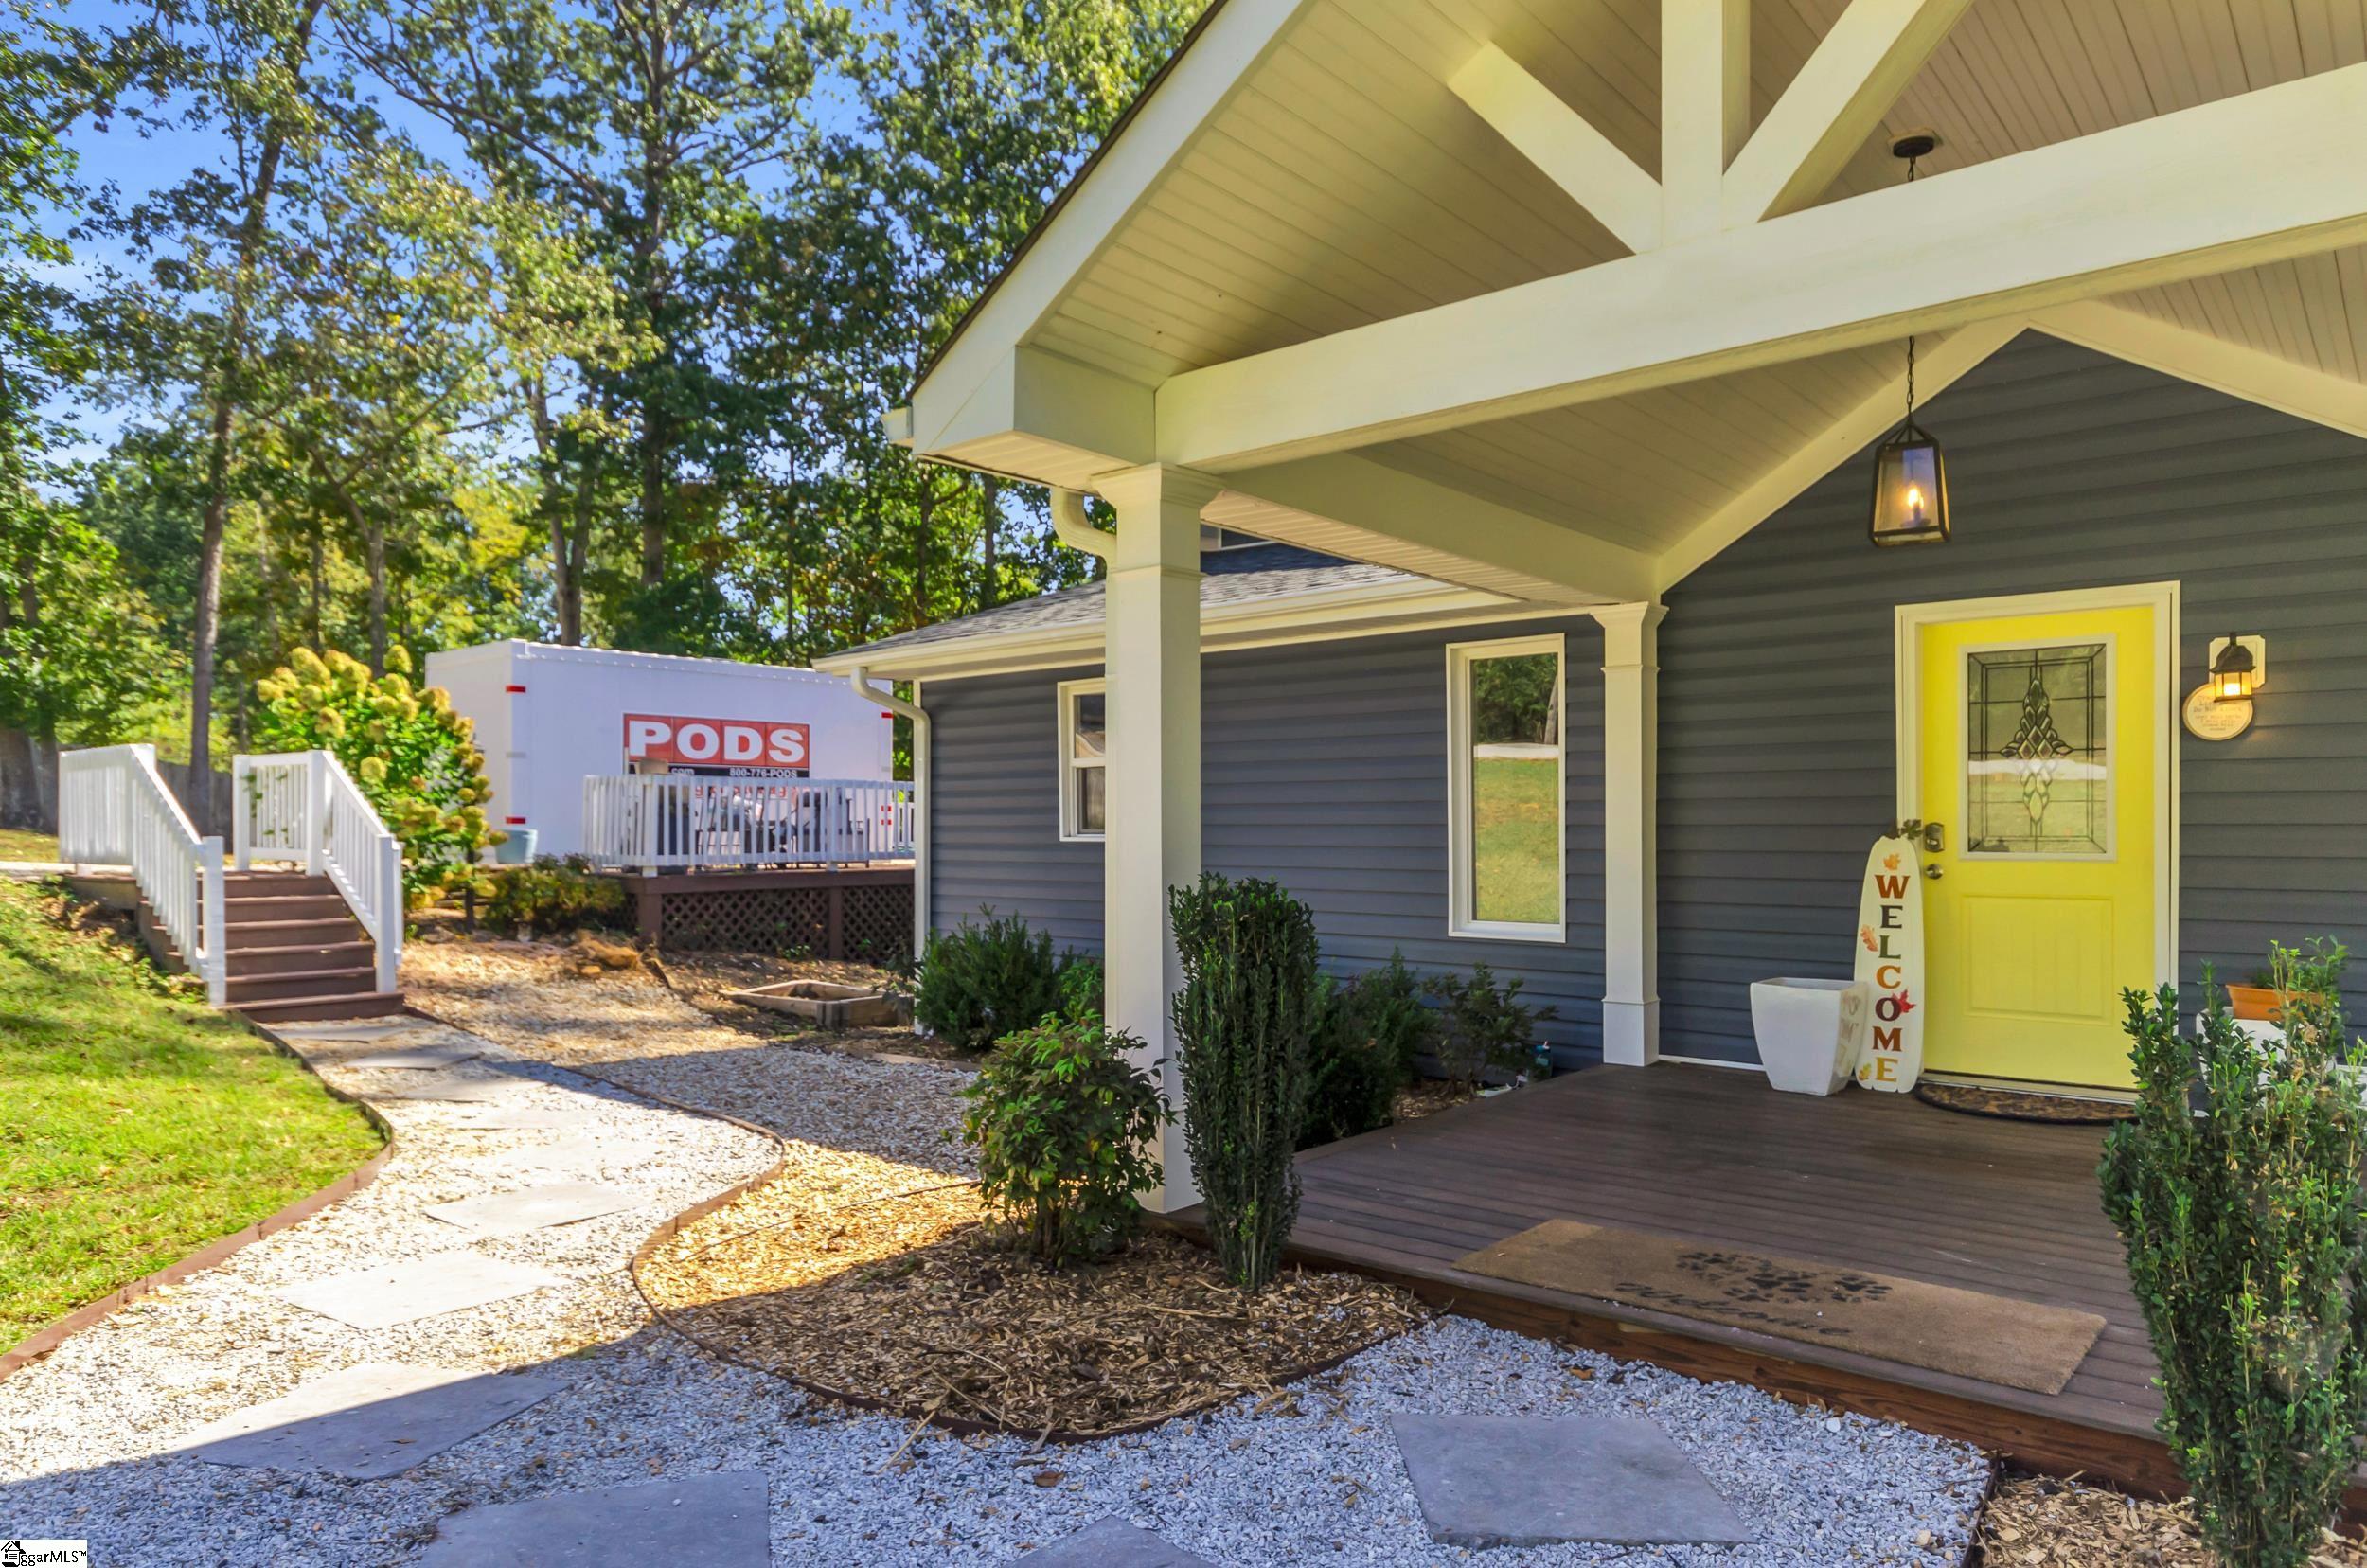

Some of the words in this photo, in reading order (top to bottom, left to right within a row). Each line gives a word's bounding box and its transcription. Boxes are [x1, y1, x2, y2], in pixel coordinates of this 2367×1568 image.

[629, 720, 805, 763] PODS
[729, 768, 798, 778] 800-776-PODS
[1872, 874, 1911, 1083] WELCOME
[1614, 1282, 1851, 1335] Welcome
